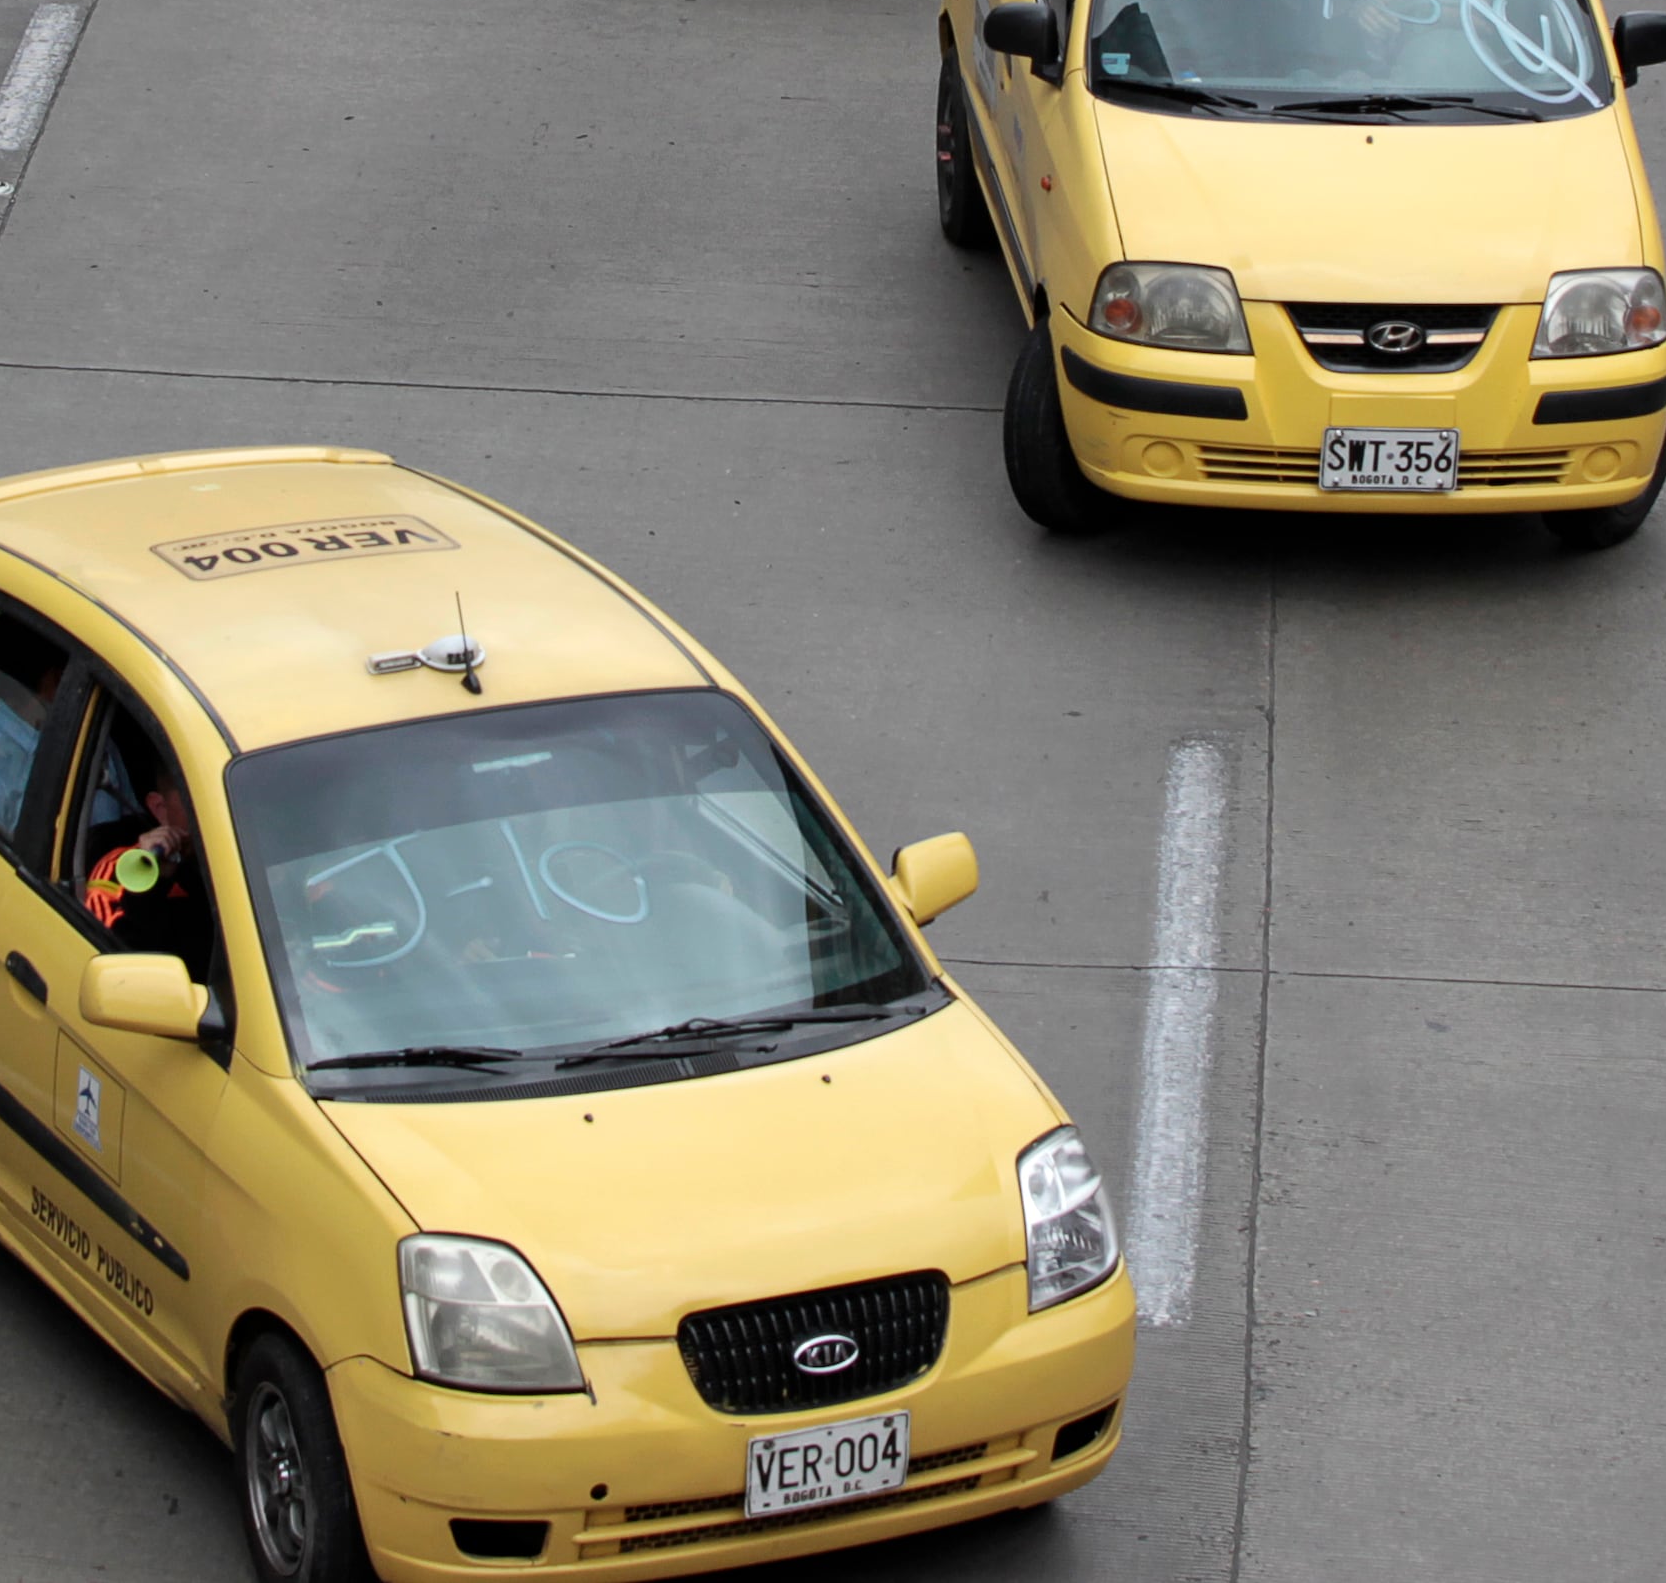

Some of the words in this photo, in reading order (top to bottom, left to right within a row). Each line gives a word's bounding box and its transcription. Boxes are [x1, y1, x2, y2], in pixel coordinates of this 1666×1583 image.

[1350, 474, 1395, 486] BOGOTA
[288, 519, 397, 535] BOGOTA
[303, 527, 439, 552] VER
[184, 541, 300, 573] 004
[30, 1184, 92, 1261] SERVICIO
[95, 1243, 155, 1317] PUBLICO
[805, 1342, 851, 1368] KIA
[782, 1484, 834, 1506] BOGOTA
